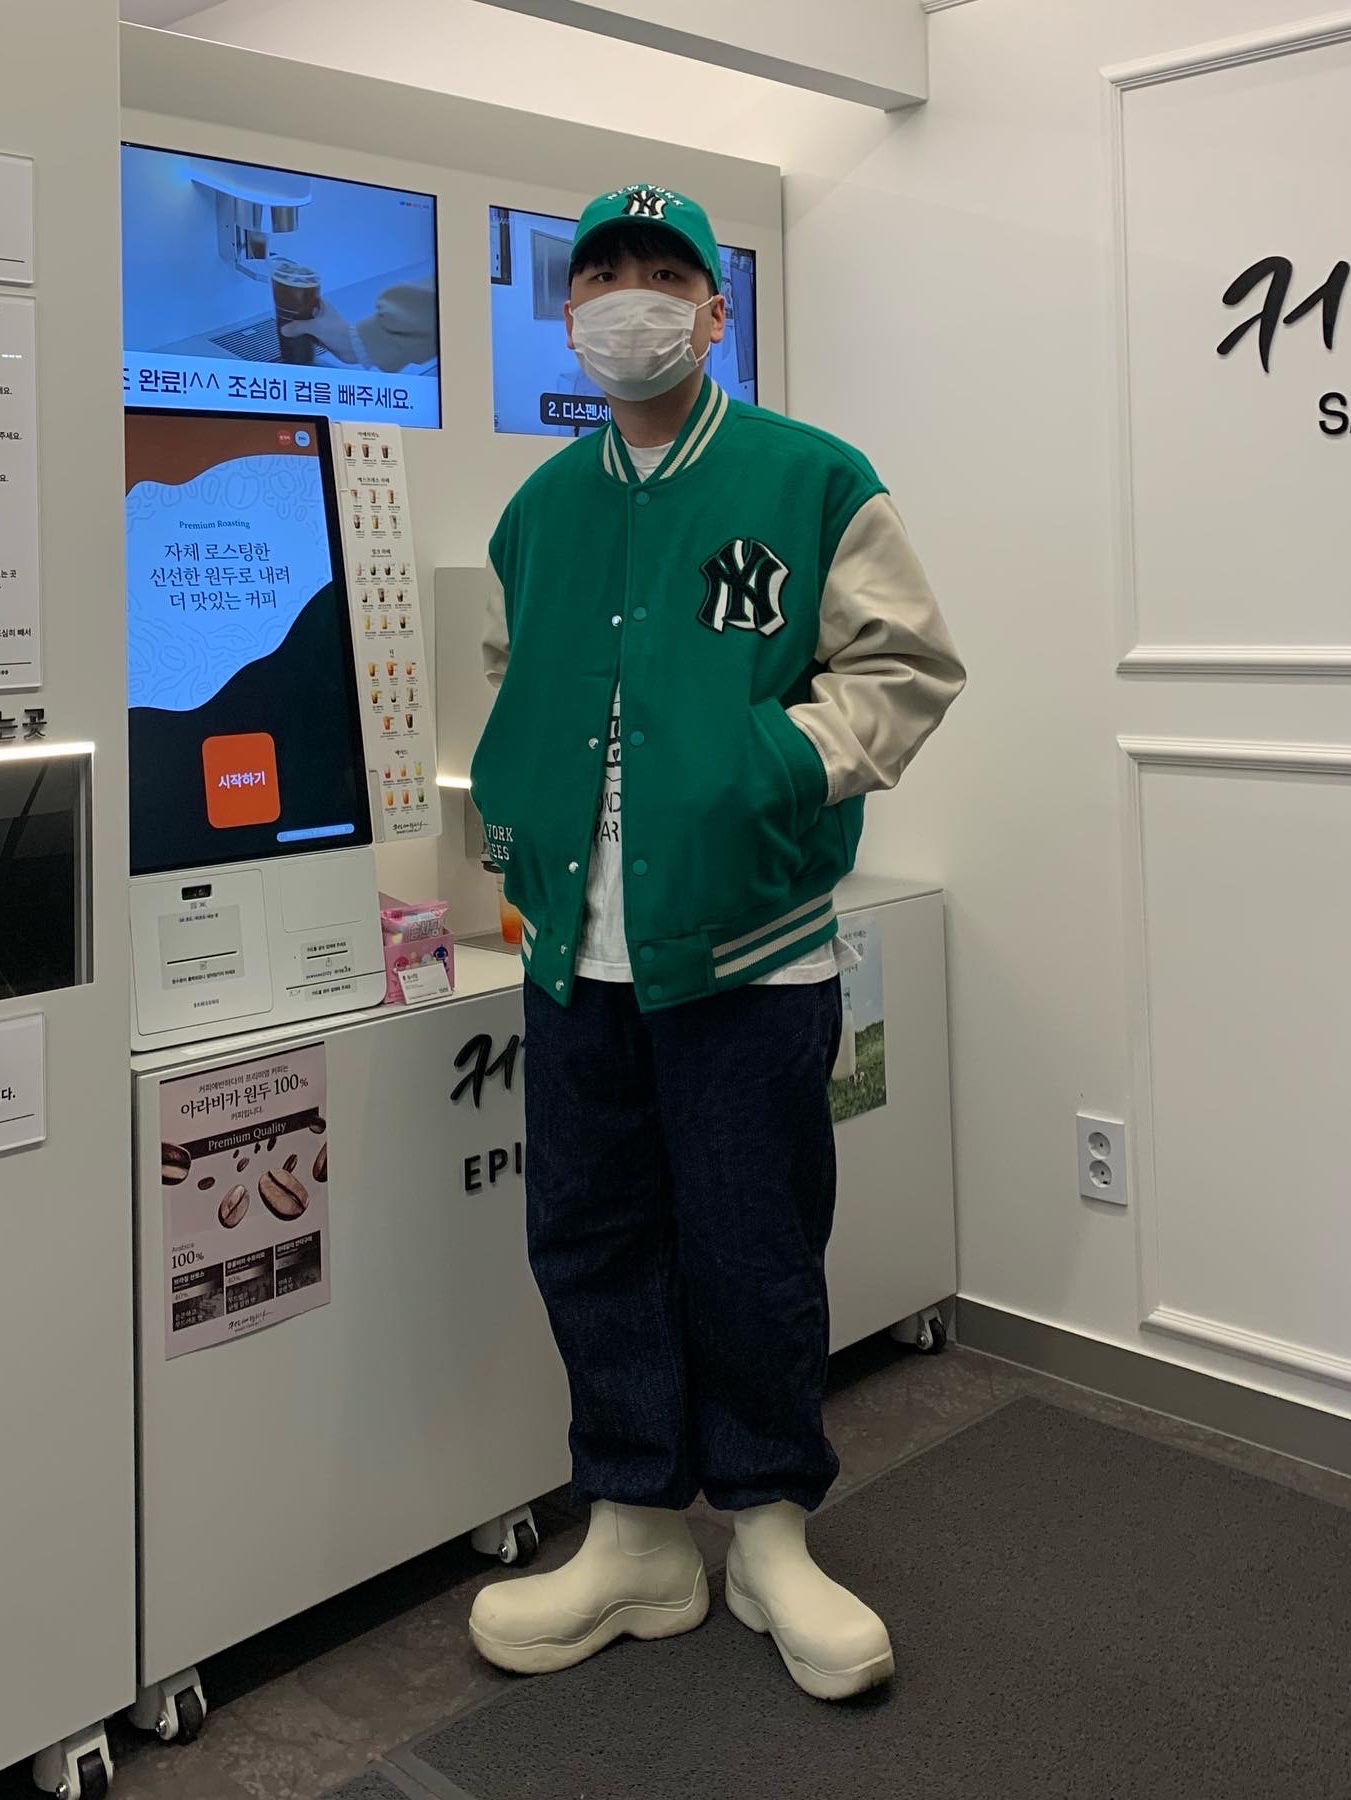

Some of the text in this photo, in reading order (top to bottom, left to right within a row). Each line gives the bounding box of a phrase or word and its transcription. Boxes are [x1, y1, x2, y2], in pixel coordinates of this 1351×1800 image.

[607, 184, 685, 207] NEW YORK
[228, 374, 288, 402] 조심히
[294, 380, 332, 404] 컵을
[337, 383, 414, 410] 빼주세요.
[548, 401, 613, 422] 2. 디스펜서
[1318, 392, 1351, 435] S
[179, 519, 251, 531] Premium Roasting
[164, 542, 271, 562] 자체 로스팅한
[150, 565, 291, 588] 신선한 원두로 내려
[169, 590, 277, 611] 더 맛있는 커피
[0, 628, 16, 639] 심히
[218, 770, 267, 789] 시작하기
[598, 791, 622, 814] ND
[486, 823, 514, 843] YORK
[488, 843, 510, 861] EES
[180, 1073, 309, 1119] 아라비카 원두 100%
[208, 1121, 287, 1151] Premium Quality
[171, 1250, 205, 1270] 100%
